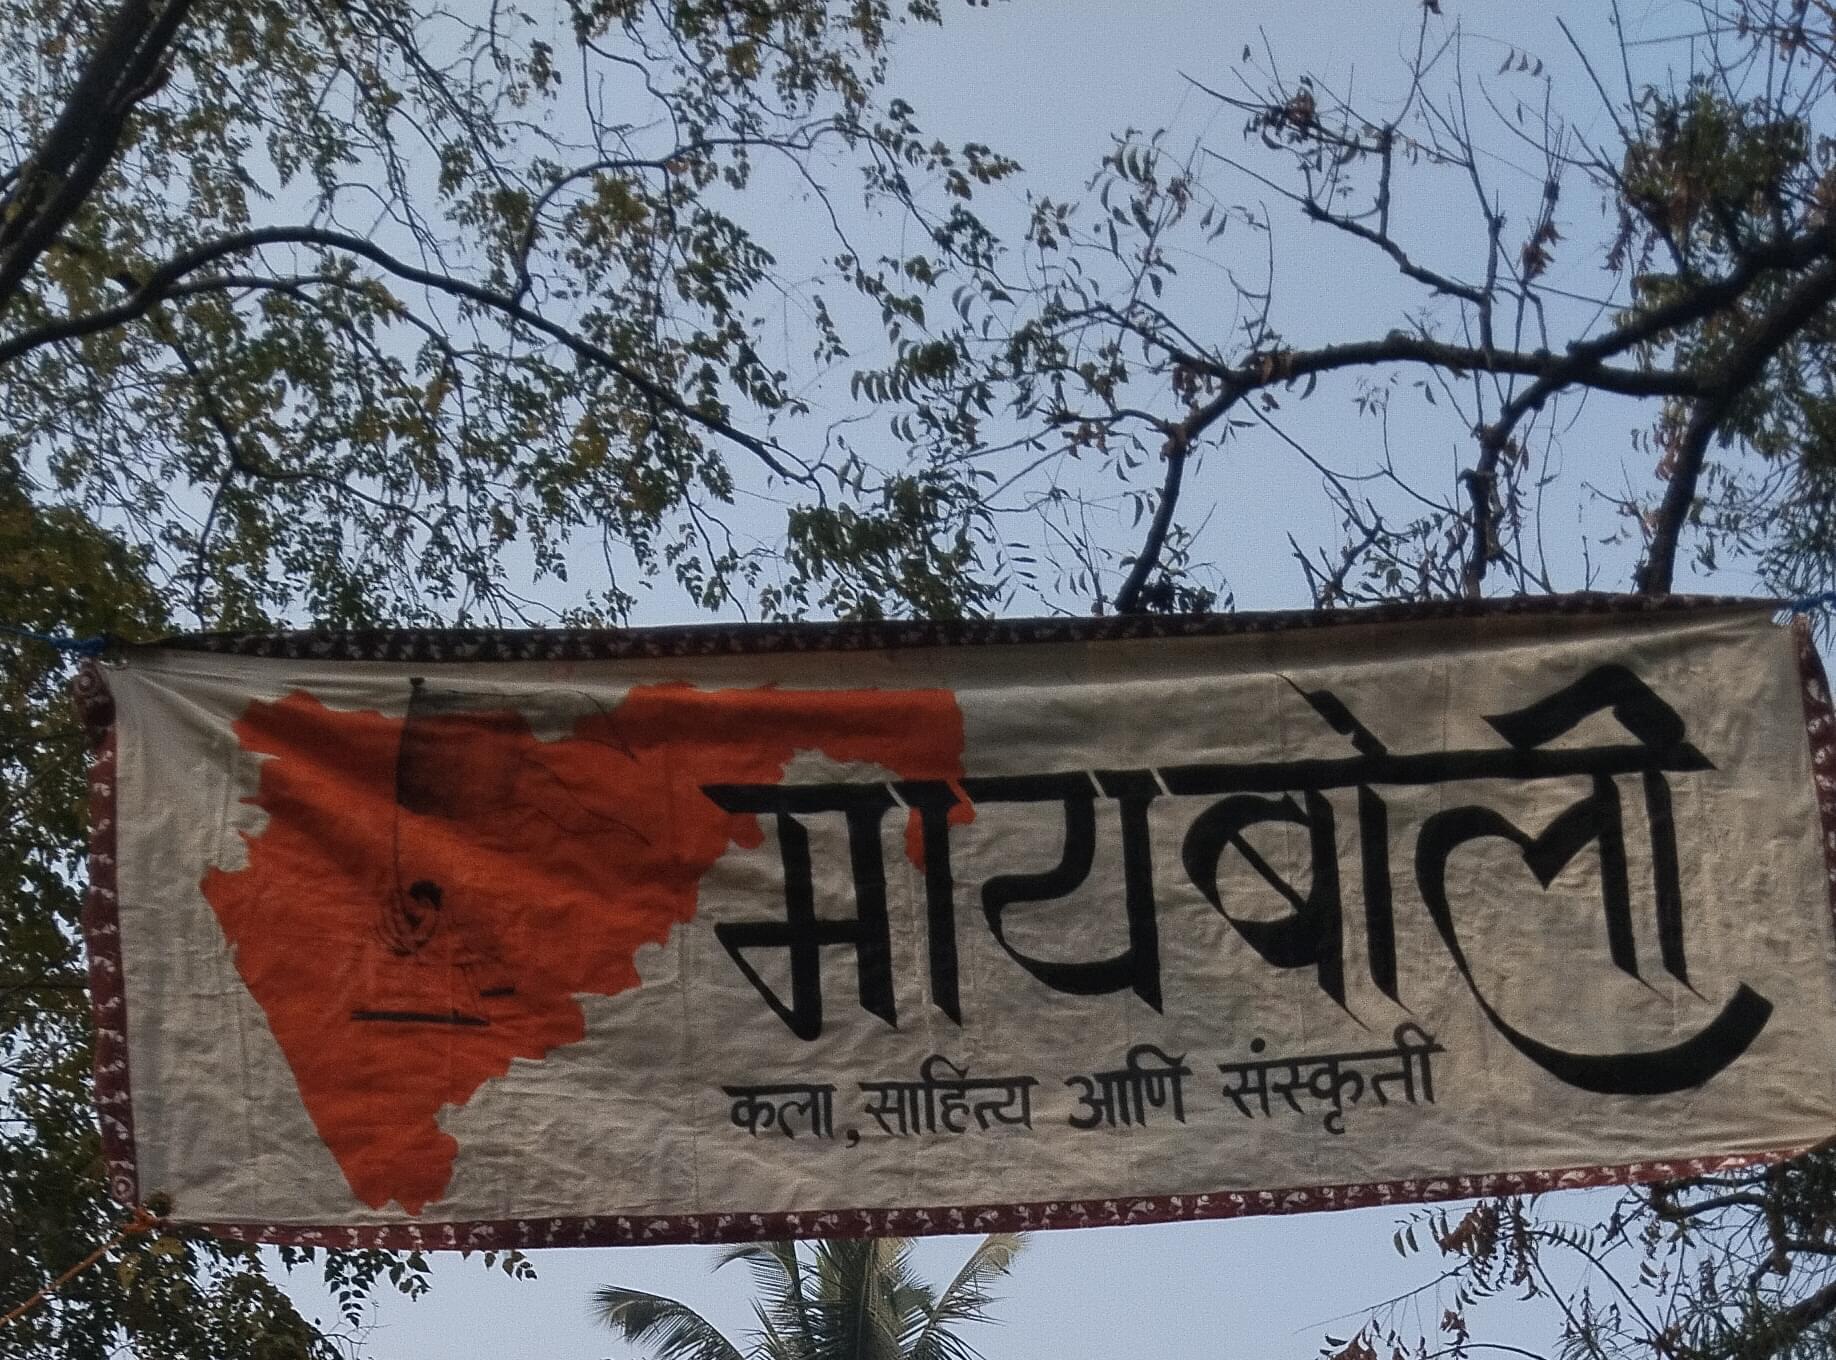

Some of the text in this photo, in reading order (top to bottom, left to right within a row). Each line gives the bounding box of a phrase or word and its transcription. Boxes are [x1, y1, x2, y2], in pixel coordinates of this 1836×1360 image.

[701, 667, 1774, 1096] मायबोली
[860, 1054, 1039, 1133] साहित्य
[1067, 1044, 1192, 1129] आणि
[1221, 1023, 1445, 1135] संस्कृती
